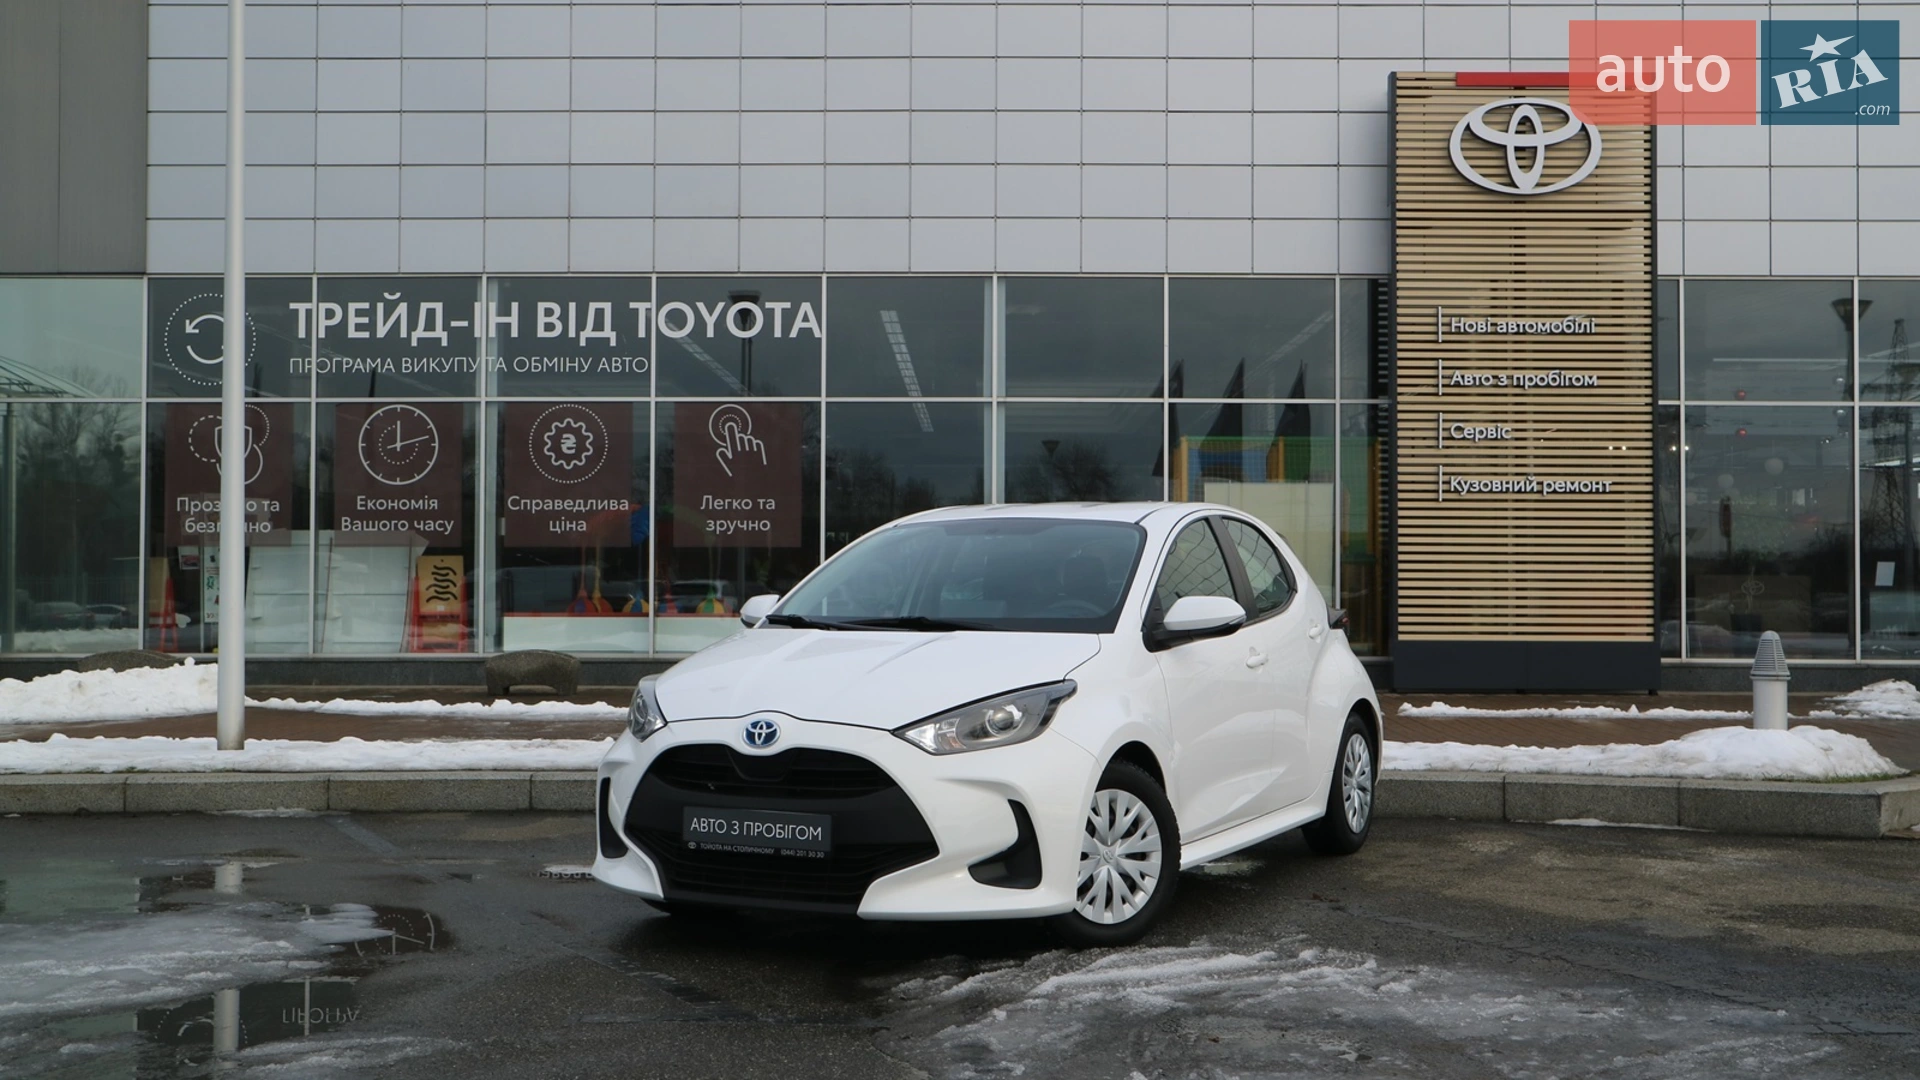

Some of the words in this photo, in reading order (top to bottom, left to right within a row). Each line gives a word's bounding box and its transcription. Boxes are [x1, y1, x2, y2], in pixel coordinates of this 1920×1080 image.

[536, 301, 617, 347] ВІД
[629, 301, 822, 339] TOYOTA
[1450, 317, 1491, 333] Нові
[1496, 318, 1596, 334] автомобілі
[289, 357, 396, 374] ПРОГРАМА
[402, 357, 481, 373] ВИКУПУ
[485, 357, 508, 373] ТА
[513, 357, 593, 373] ОБМІНУ
[597, 357, 649, 373] АВТО
[1451, 371, 1493, 386] Авто
[1497, 374, 1508, 387] з
[1513, 371, 1598, 389] пробігом
[1450, 424, 1512, 442] Сервіс
[1450, 476, 1537, 495] Кузовний
[1543, 480, 1612, 496] ремонт
[177, 497, 257, 515] Прозо
[262, 501, 280, 511] та
[356, 496, 438, 510] Економія
[507, 497, 629, 514] Справедлива
[700, 496, 752, 510] Легко
[757, 500, 776, 510] та
[341, 518, 409, 531] Вашого
[414, 521, 454, 534] часу
[550, 518, 587, 534] ціна
[706, 521, 771, 535] зручно
[690, 817, 727, 834] АВТО
[743, 821, 823, 841] ПРОБІГОМ
